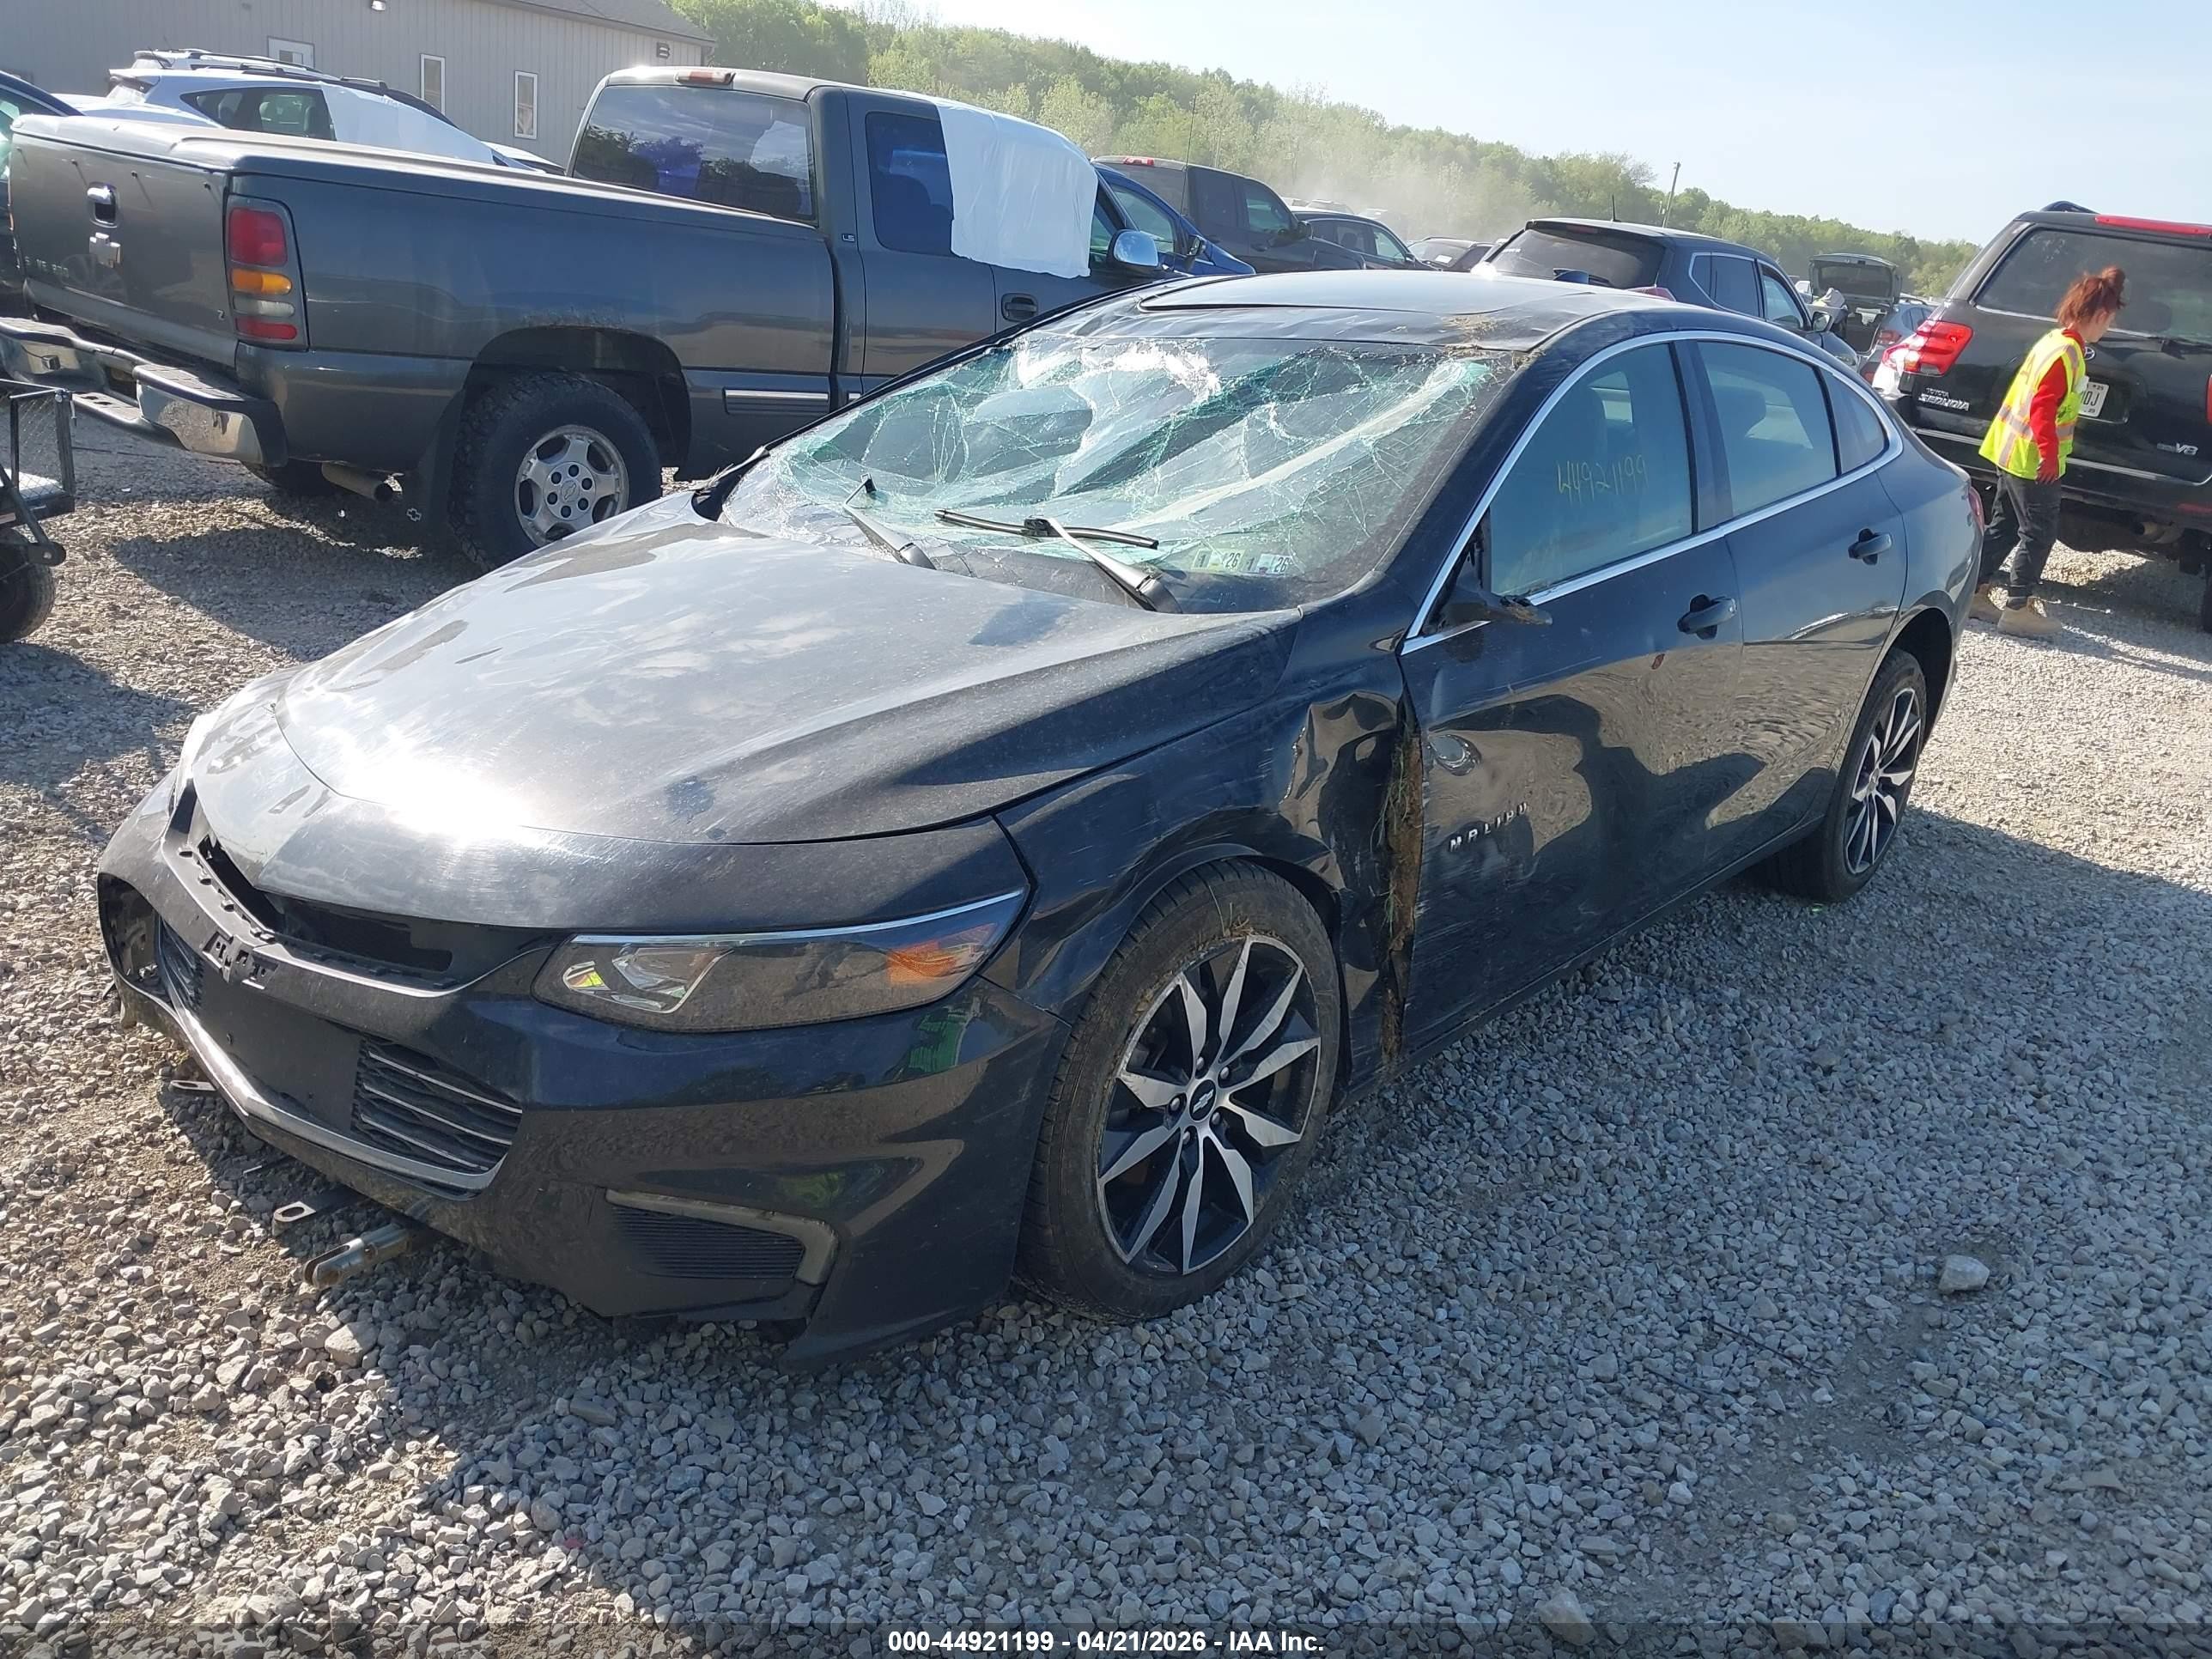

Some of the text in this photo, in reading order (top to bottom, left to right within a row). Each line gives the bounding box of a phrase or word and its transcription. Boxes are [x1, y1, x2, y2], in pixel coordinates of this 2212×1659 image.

[1925, 387, 1949, 398] TOYOTA
[1918, 392, 1970, 411] SEQUOIA
[2176, 442, 2198, 456] V8
[1556, 453, 1650, 504] 44921199
[1225, 552, 1242, 569] 26
[1274, 556, 1290, 573] 26
[1449, 801, 1528, 853] MALIBU
